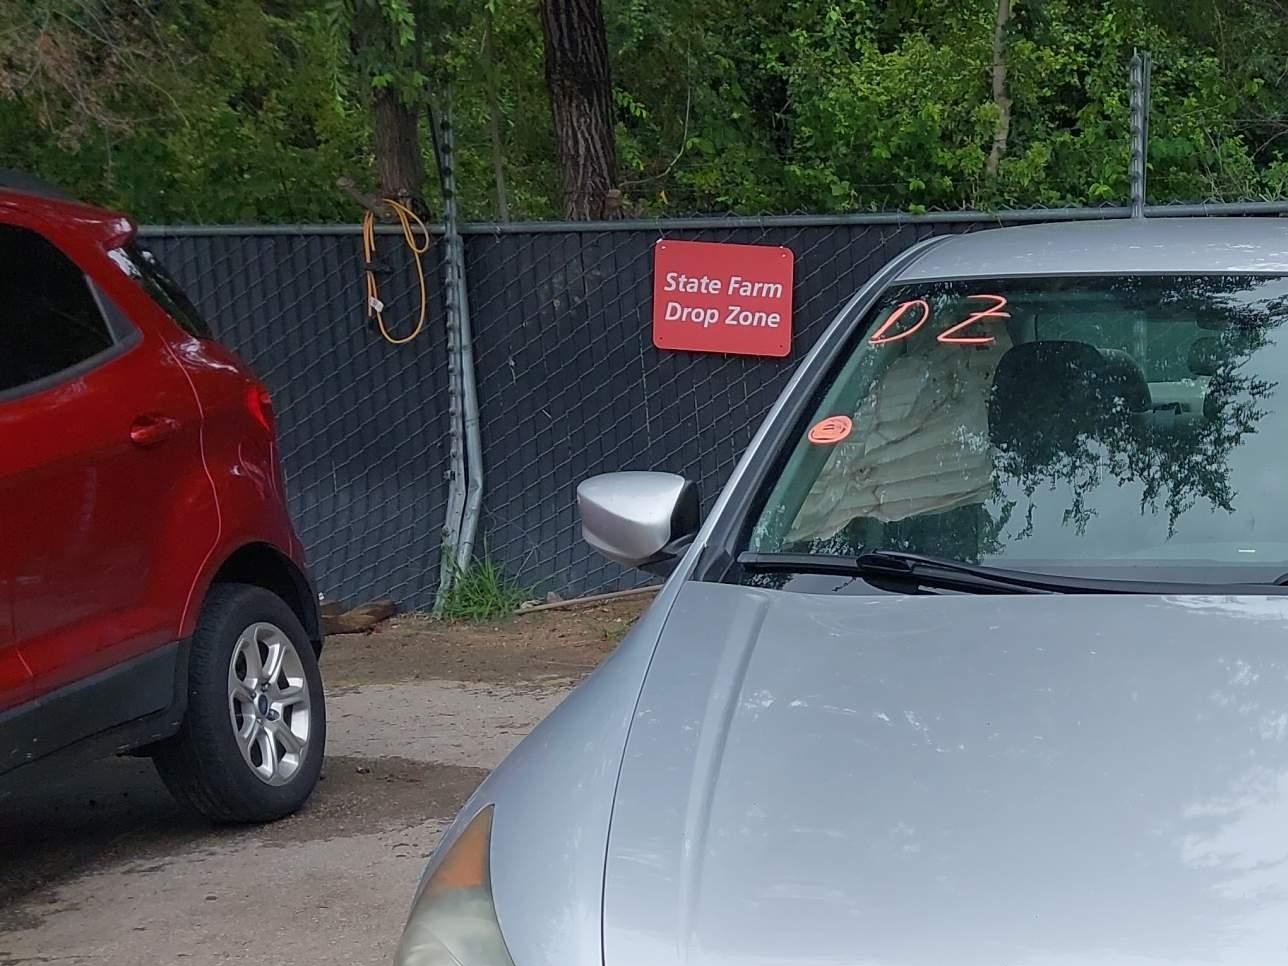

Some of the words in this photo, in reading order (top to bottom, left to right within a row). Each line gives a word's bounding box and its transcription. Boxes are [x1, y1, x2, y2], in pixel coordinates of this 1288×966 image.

[663, 272, 722, 294] State
[727, 276, 783, 298] Farm
[665, 302, 719, 328] Drop
[725, 306, 781, 328] Zone
